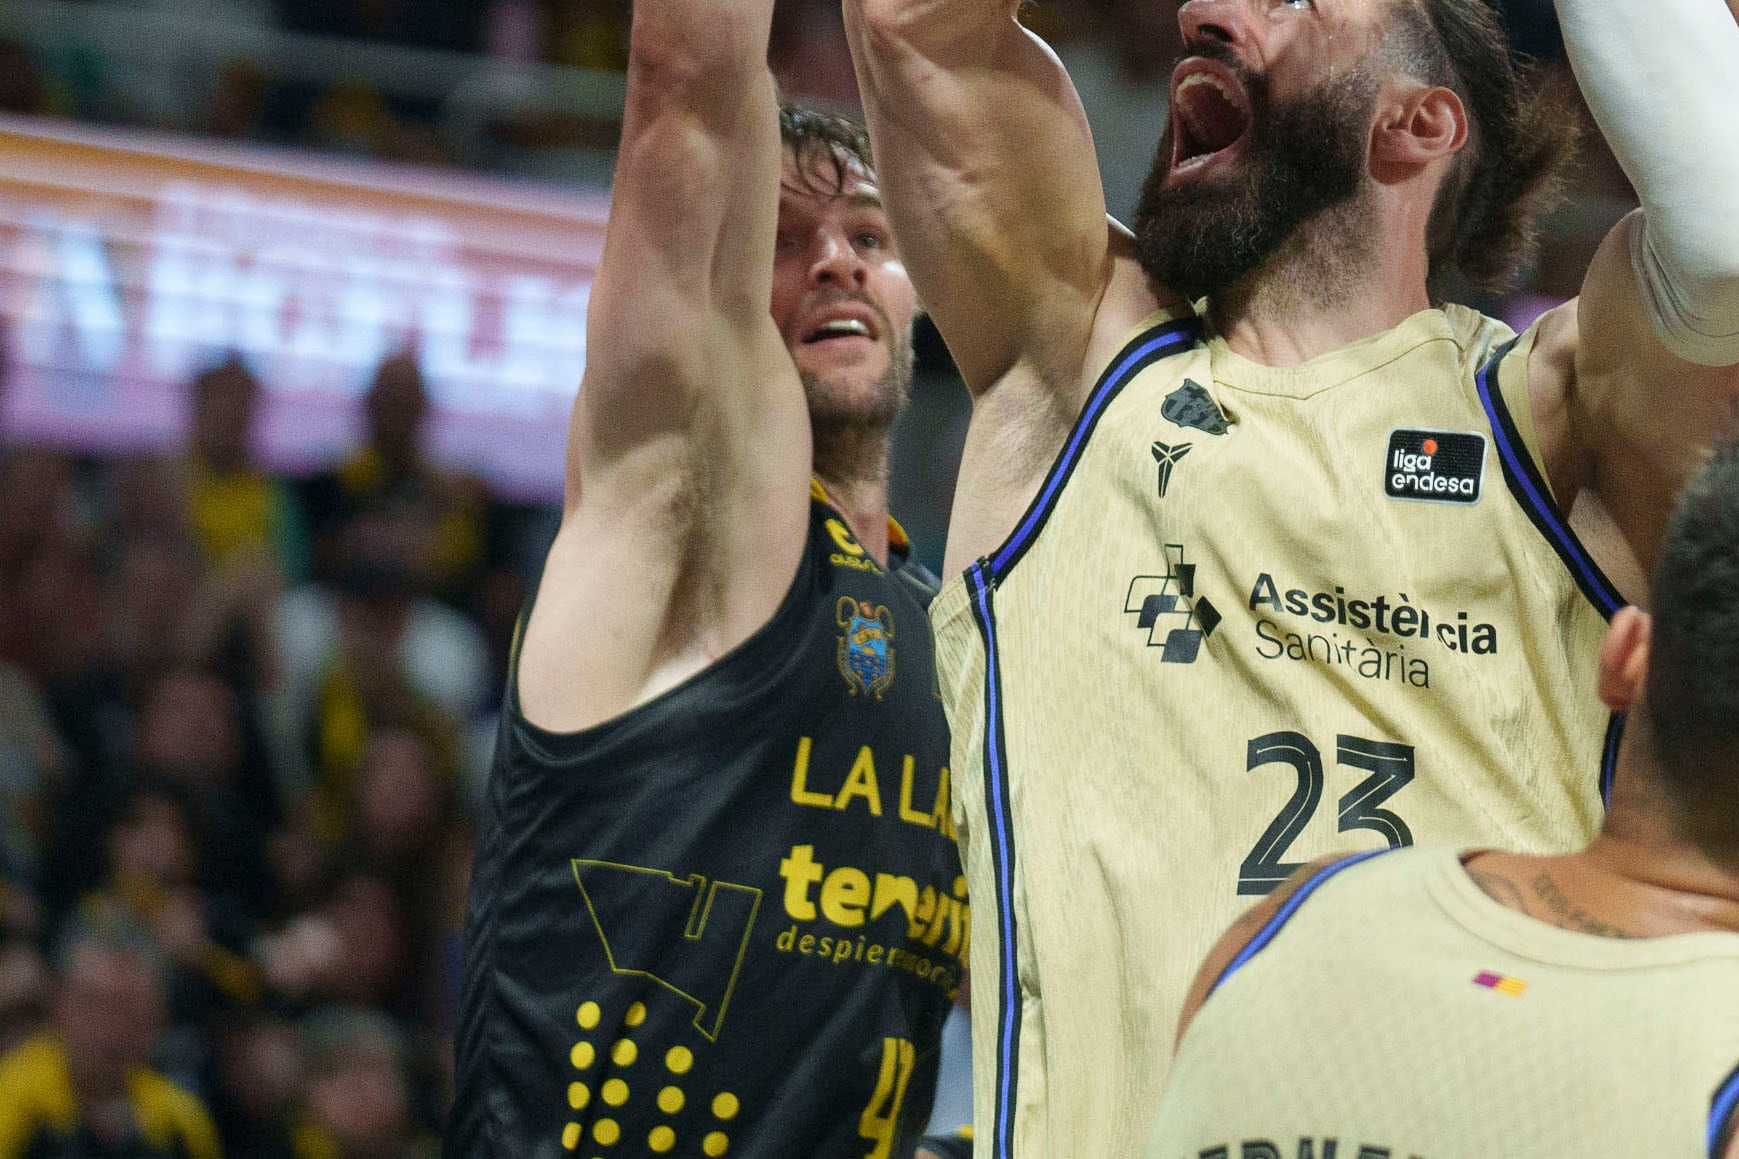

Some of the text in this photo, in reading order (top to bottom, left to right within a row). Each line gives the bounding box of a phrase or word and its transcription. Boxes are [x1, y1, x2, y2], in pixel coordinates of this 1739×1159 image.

[1391, 471, 1474, 494] endesa
[1393, 448, 1432, 472] liga
[1255, 618, 1430, 689] Sanitària
[790, 736, 883, 817] LA
[1236, 730, 1415, 896] 23
